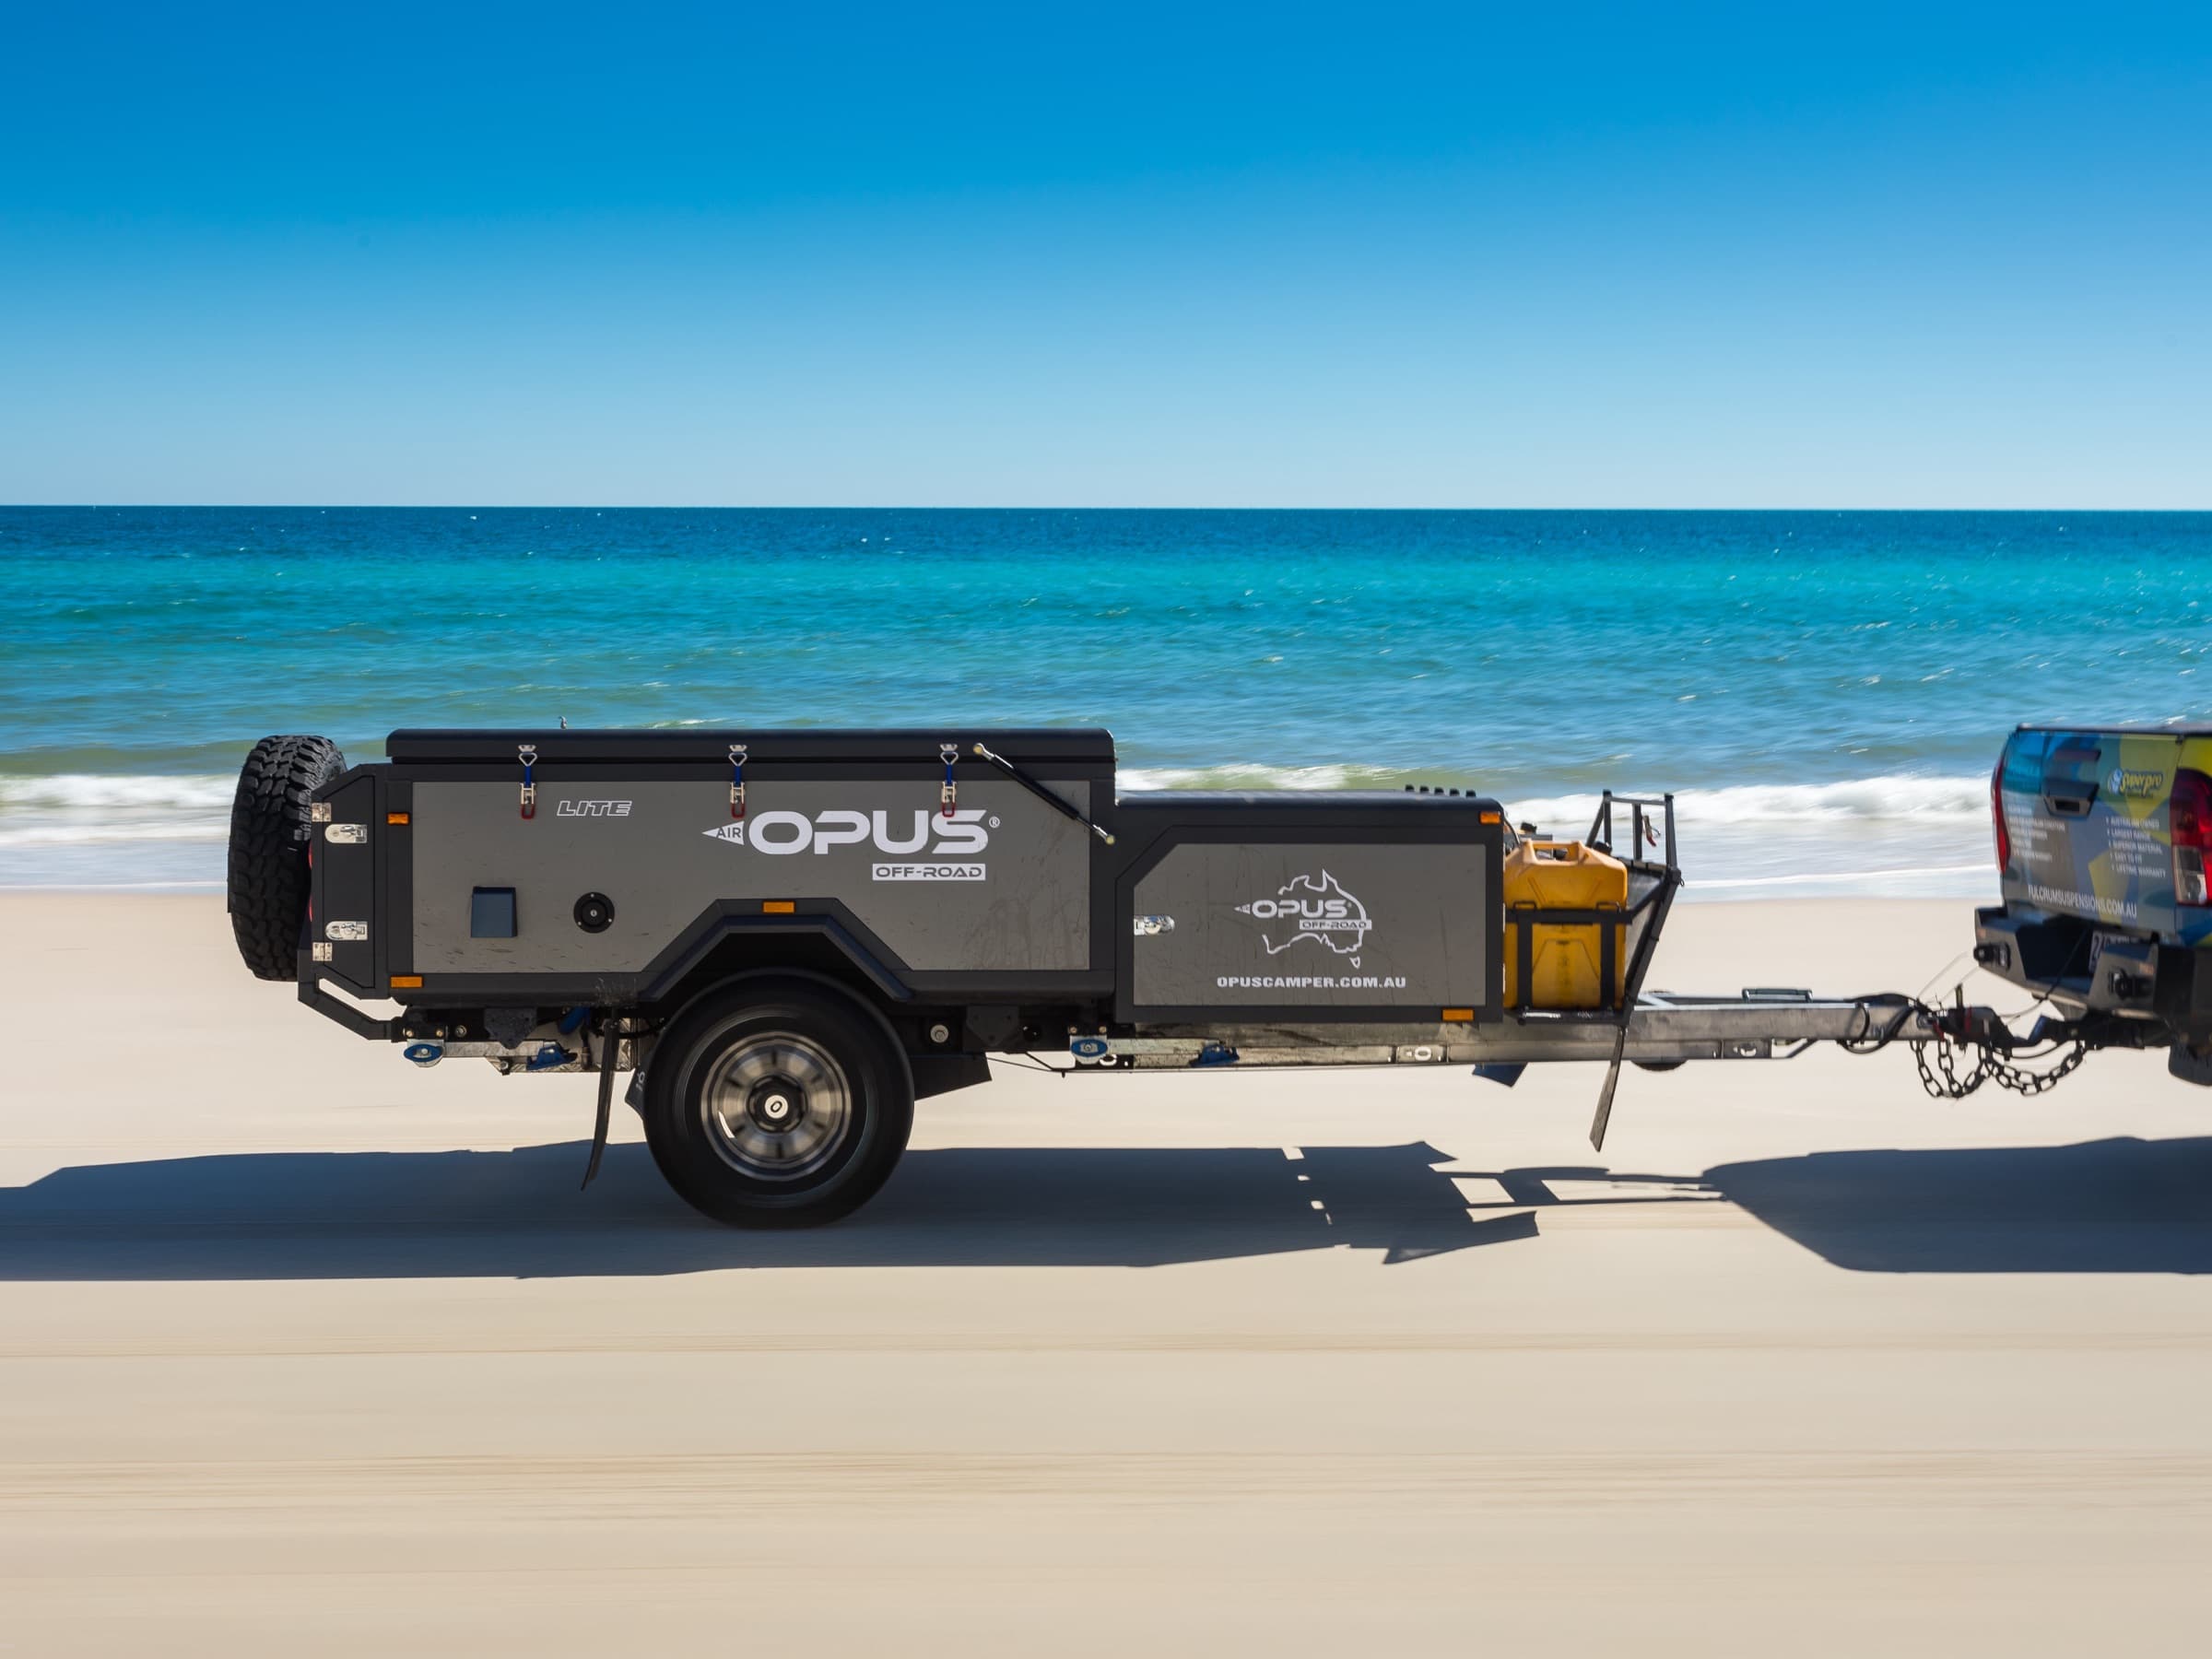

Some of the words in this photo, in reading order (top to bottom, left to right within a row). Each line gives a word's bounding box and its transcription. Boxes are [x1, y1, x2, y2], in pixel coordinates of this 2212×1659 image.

[556, 800, 632, 817] LITE
[715, 826, 742, 840] AIR
[875, 865, 982, 878] OFF-ROAD
[1301, 921, 1368, 929] OFF-ROAD
[1217, 976, 1406, 988] OPUSCAMPER.COM.AU
